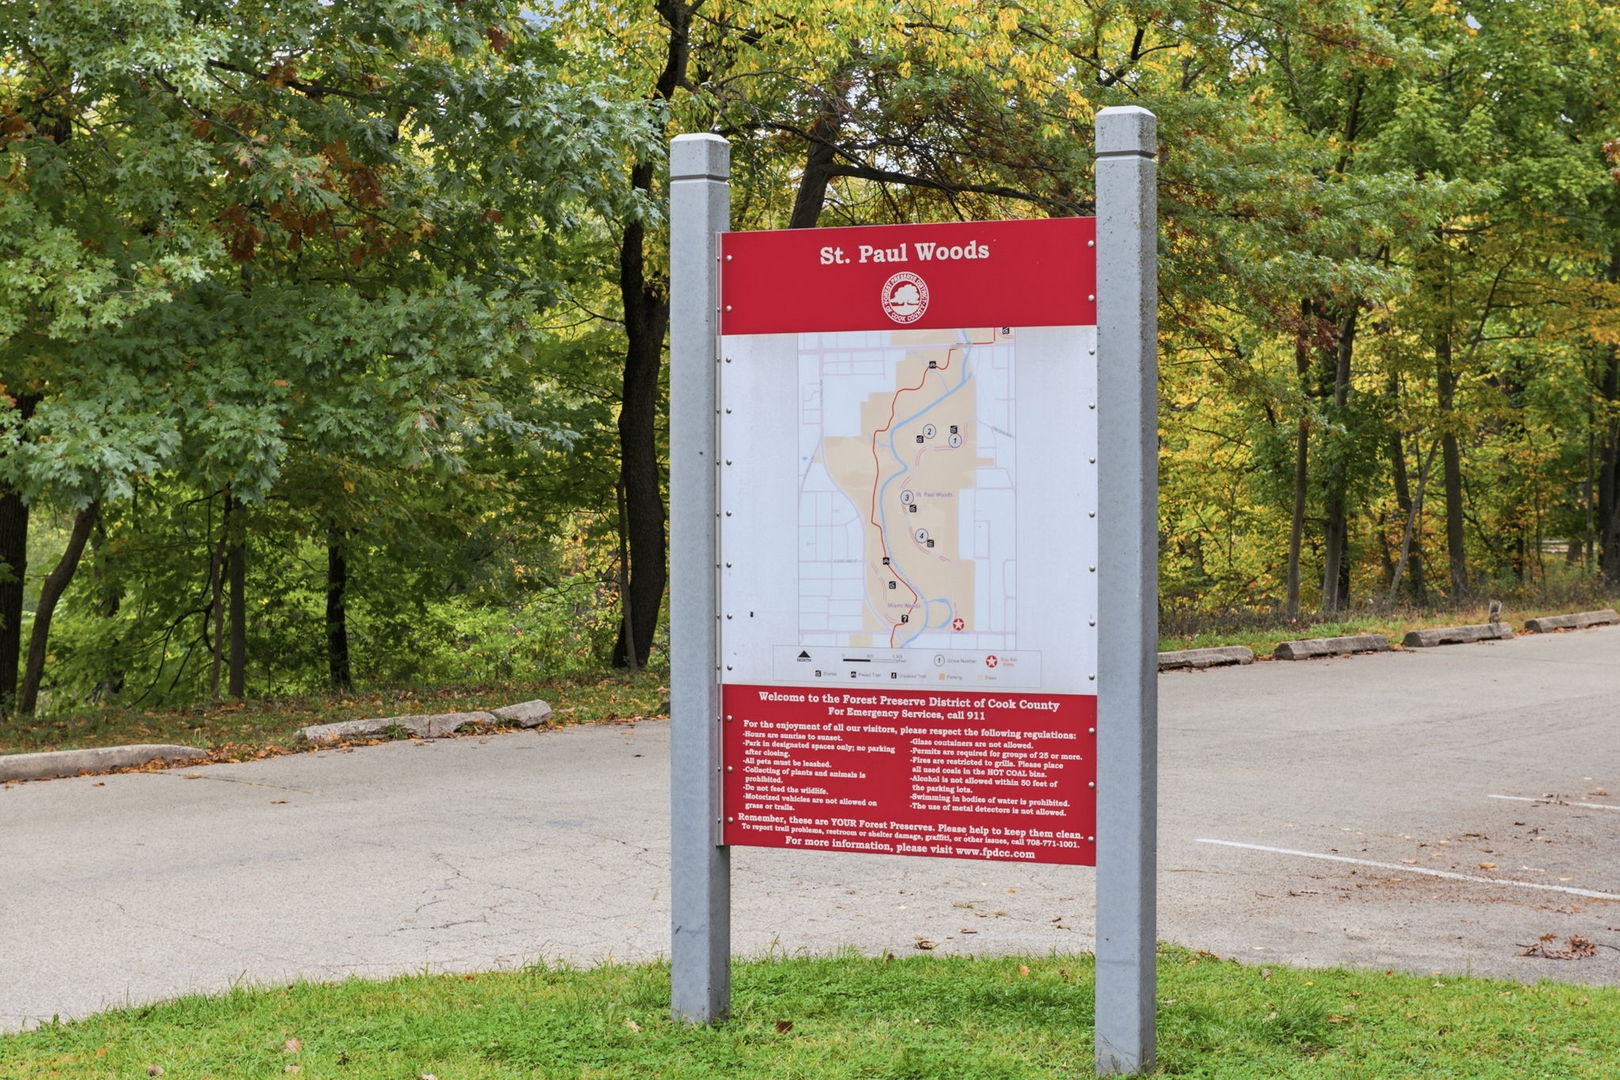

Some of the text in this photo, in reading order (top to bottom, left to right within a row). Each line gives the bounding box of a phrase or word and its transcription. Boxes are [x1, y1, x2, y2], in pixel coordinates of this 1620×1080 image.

[821, 240, 989, 264] St. Paul Woods
[758, 691, 1060, 712] Welcome to the Forest Preserve District of Cook County
[828, 706, 985, 720] For Emergency Services, call 911
[743, 719, 758, 727] For
[759, 720, 774, 728] the
[775, 721, 820, 731] enjoyment
[833, 723, 844, 731] all
[862, 724, 897, 734] visitors,
[900, 726, 927, 735] please
[929, 728, 961, 737] respect
[963, 727, 978, 736] the
[981, 728, 1021, 739] following
[1023, 730, 1076, 740] regulations:
[771, 740, 809, 749] designated
[811, 743, 835, 751] spaces
[867, 745, 895, 754] parking
[933, 739, 973, 747] containers
[956, 749, 987, 758] required
[989, 749, 1000, 757] for
[756, 758, 771, 766] pets
[946, 758, 983, 766] restricted
[1017, 760, 1041, 768] Please
[1043, 761, 1063, 770] place
[790, 768, 813, 776] plants
[829, 770, 857, 778] animals
[987, 768, 1004, 776] HOT
[1005, 769, 1027, 777] COAL
[964, 777, 993, 785] allowed
[994, 778, 1019, 786] within
[1032, 779, 1047, 787] feet
[926, 785, 955, 794] parking
[961, 795, 986, 803] bodies
[942, 803, 951, 811] of
[974, 805, 1010, 813] detectors
[1012, 806, 1019, 814] is
[738, 812, 786, 824] Remember,
[789, 815, 812, 824] these
[830, 818, 857, 827] YOUR
[859, 819, 887, 829] Forest
[889, 821, 935, 831] Preserves.
[937, 823, 966, 833] Please
[969, 825, 989, 835] help
[991, 827, 1001, 835] to
[1004, 827, 1026, 837] keep
[1029, 828, 1053, 838] them
[1055, 830, 1083, 839] clean.
[752, 824, 773, 832] report
[868, 830, 893, 838] shelter
[963, 835, 983, 843] other
[785, 835, 802, 845] For
[832, 838, 893, 852] information,
[896, 842, 927, 853] please
[930, 844, 953, 854] visit
[955, 847, 1035, 859] www.fpdcc.com
